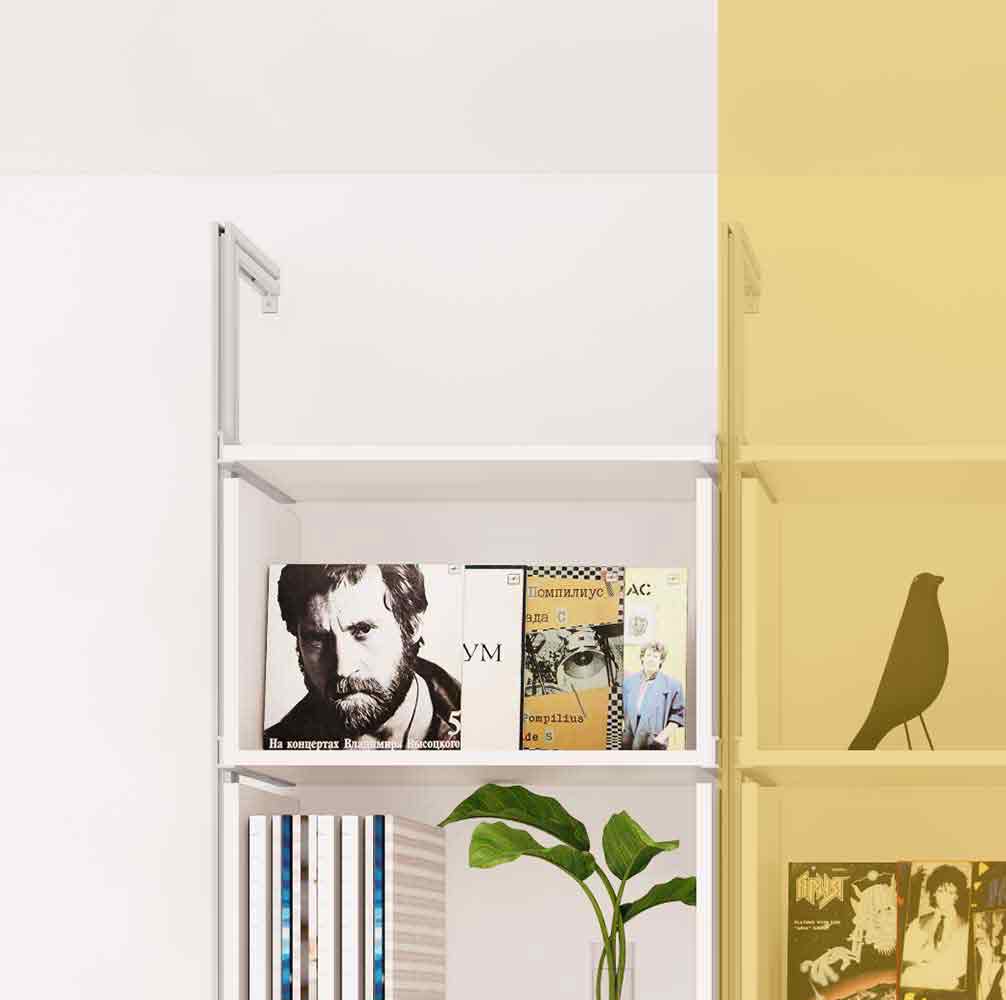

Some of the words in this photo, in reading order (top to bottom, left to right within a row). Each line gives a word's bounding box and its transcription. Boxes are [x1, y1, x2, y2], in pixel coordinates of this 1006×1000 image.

[447, 711, 461, 735] 5
[269, 738, 283, 749] На
[287, 740, 340, 751] концертах
